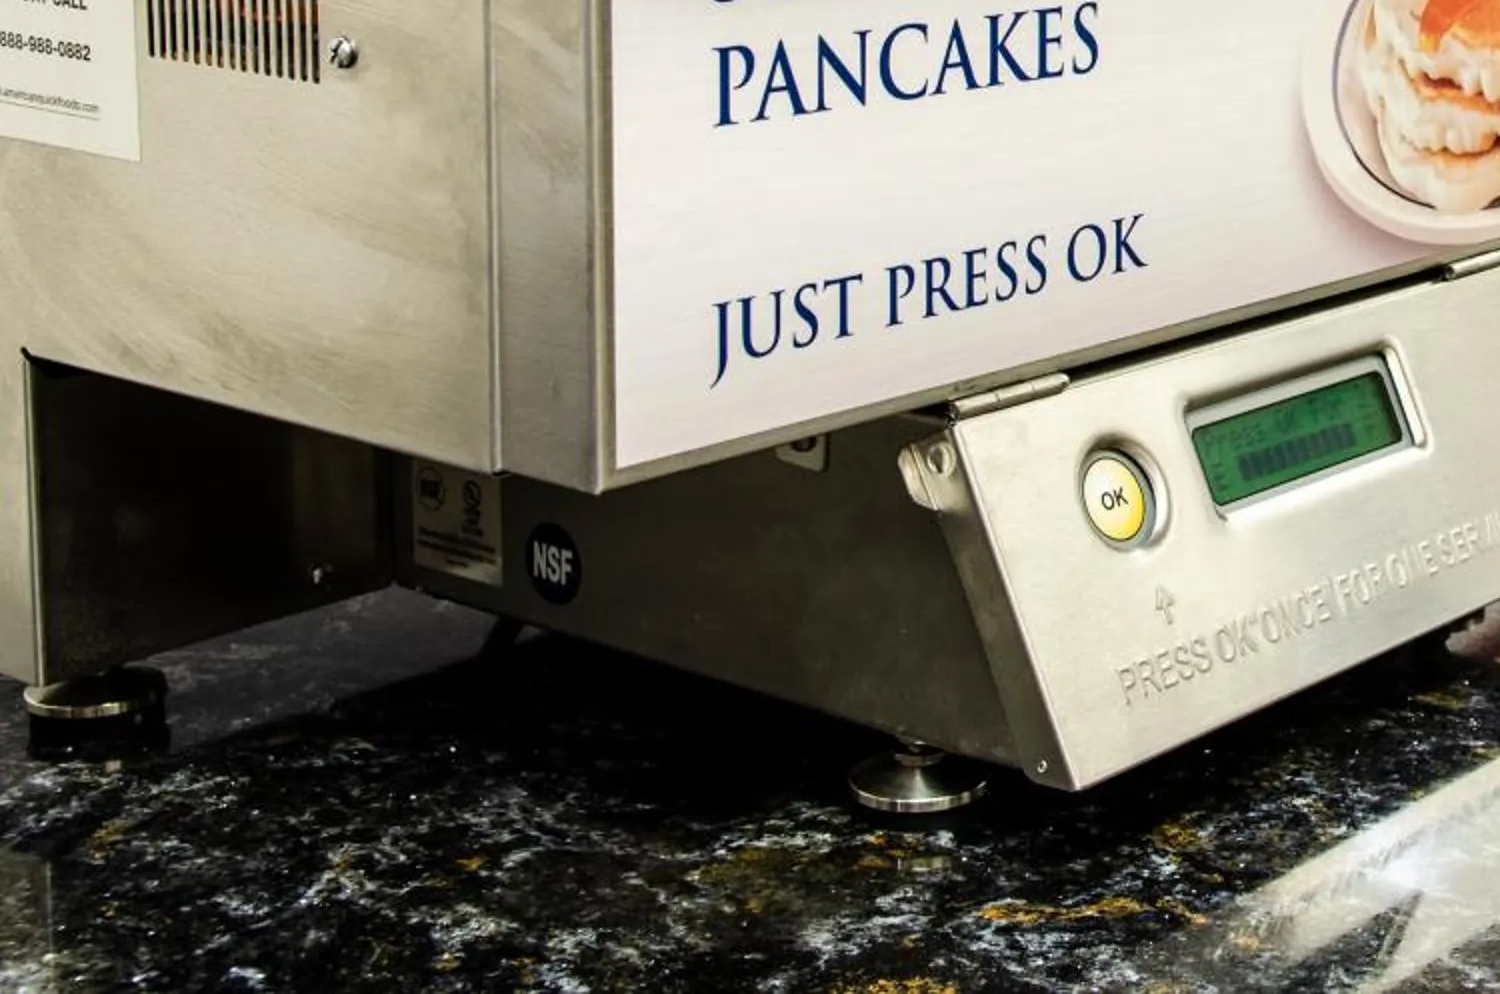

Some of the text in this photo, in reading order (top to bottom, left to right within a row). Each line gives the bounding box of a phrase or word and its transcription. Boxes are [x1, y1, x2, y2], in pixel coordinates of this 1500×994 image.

[712, 1, 1100, 129] PANCAKES
[709, 213, 1149, 390] JUST PRESS OK
[532, 539, 574, 586] NSF
[1101, 486, 1129, 511] OK
[1115, 636, 1213, 706] PRESS
[1215, 616, 1258, 664] OK
[1332, 562, 1384, 618] FOR
[1384, 539, 1440, 589] ONE
